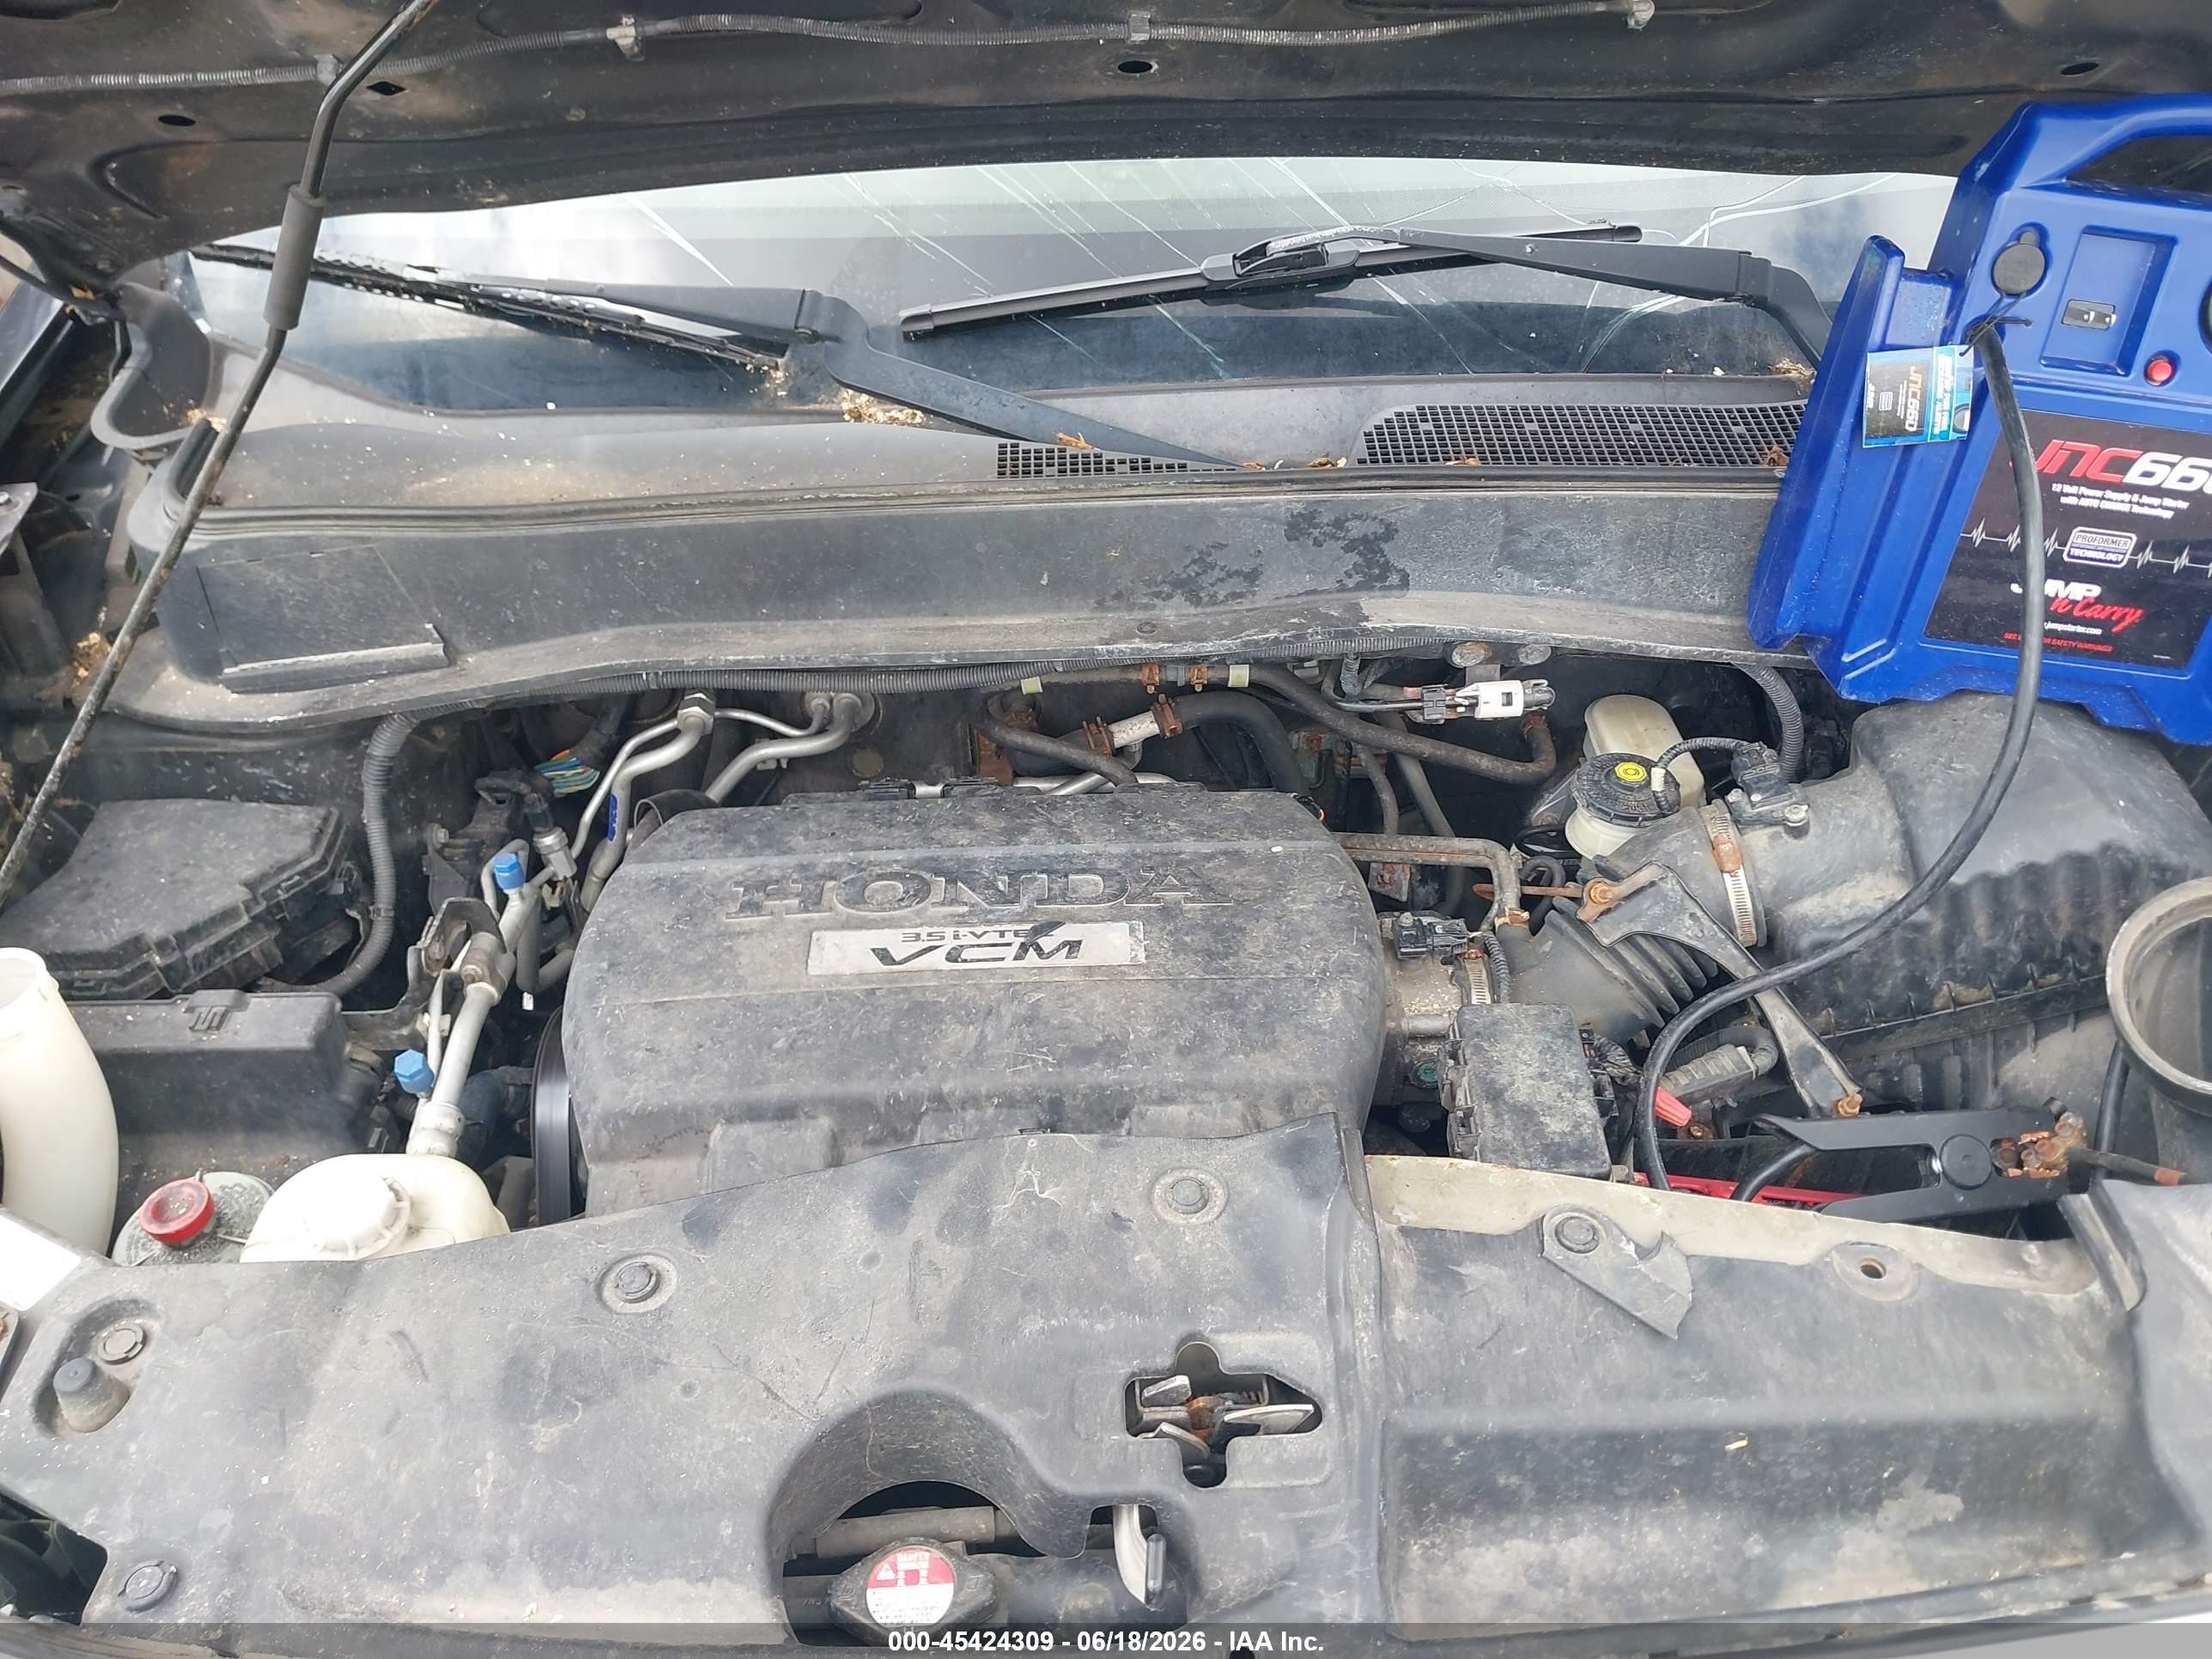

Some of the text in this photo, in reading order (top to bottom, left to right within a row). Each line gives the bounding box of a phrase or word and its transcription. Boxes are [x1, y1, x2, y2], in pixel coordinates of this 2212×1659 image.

[2075, 534, 2129, 549] PROFORMER
[2069, 548, 2125, 562] TECHNOLOGY
[2073, 596, 2144, 634] Carry
[2051, 637, 2076, 648] SAFETY
[724, 867, 1234, 920] HONDA
[902, 928, 1054, 943] 3.5 i-VTE
[870, 939, 1084, 966] VCM
